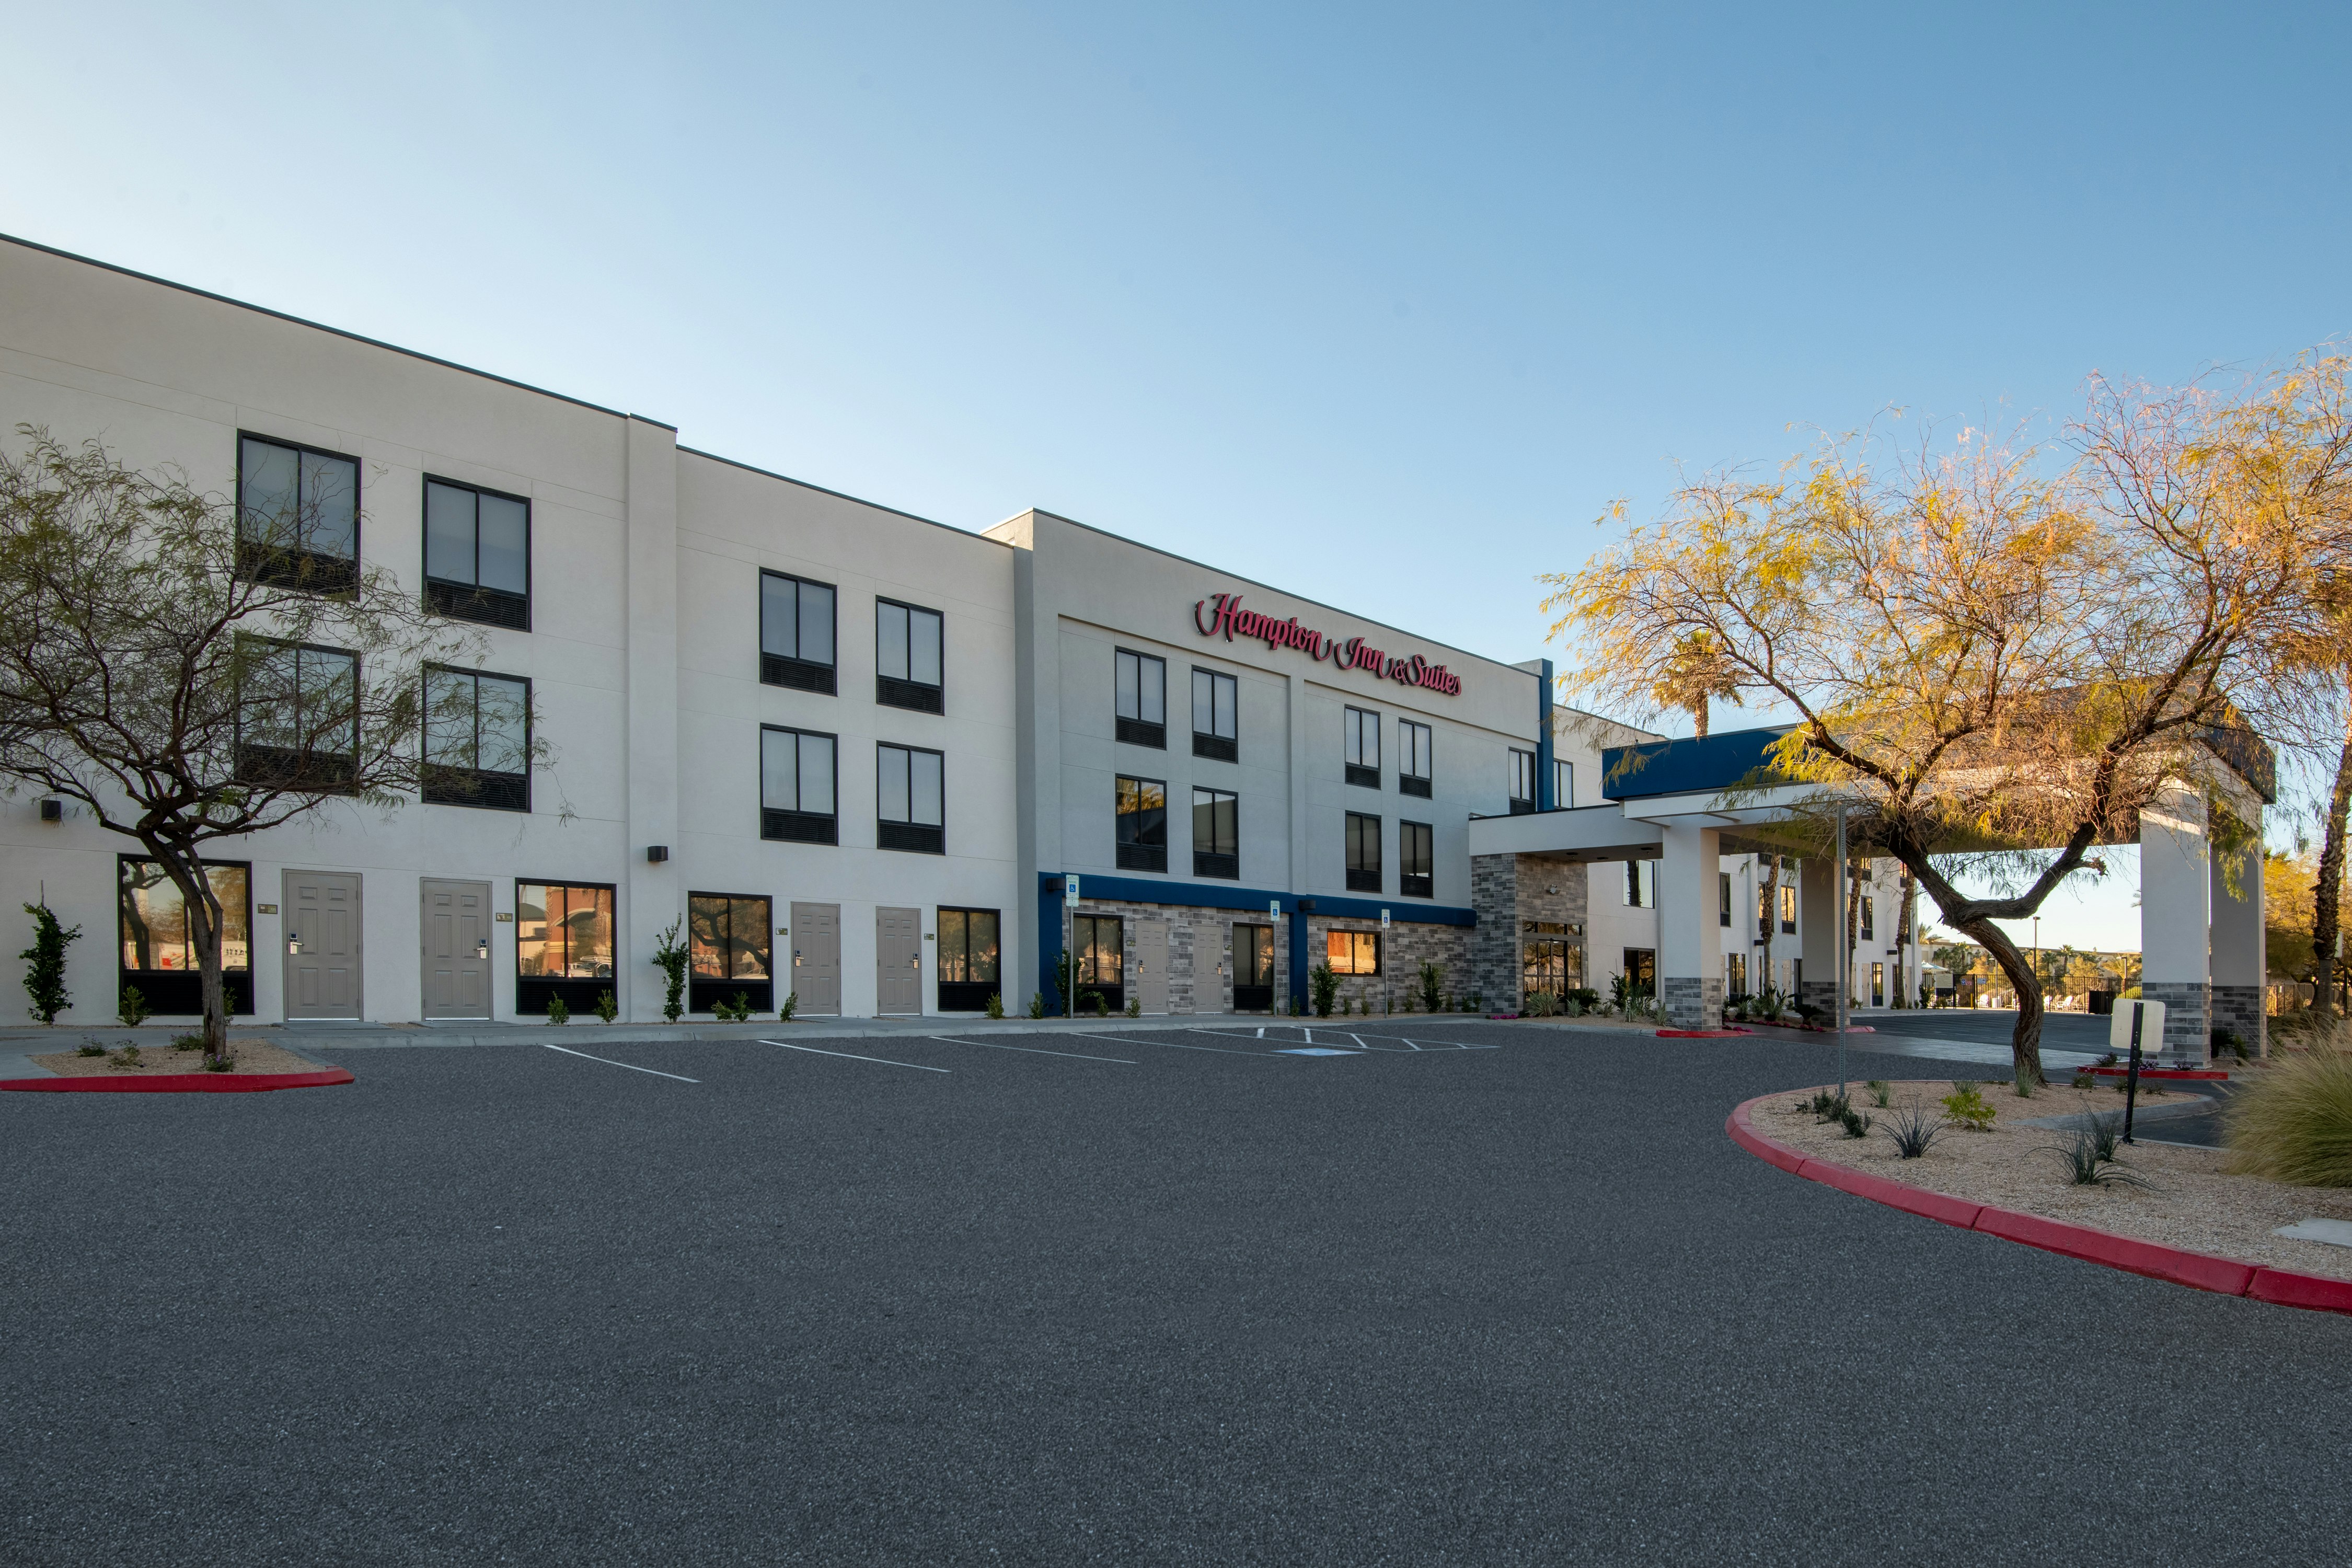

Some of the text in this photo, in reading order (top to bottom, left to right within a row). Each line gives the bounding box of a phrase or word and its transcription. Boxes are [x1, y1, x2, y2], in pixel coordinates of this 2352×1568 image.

[1195, 593, 1462, 696] Hampton Inn & Suites
